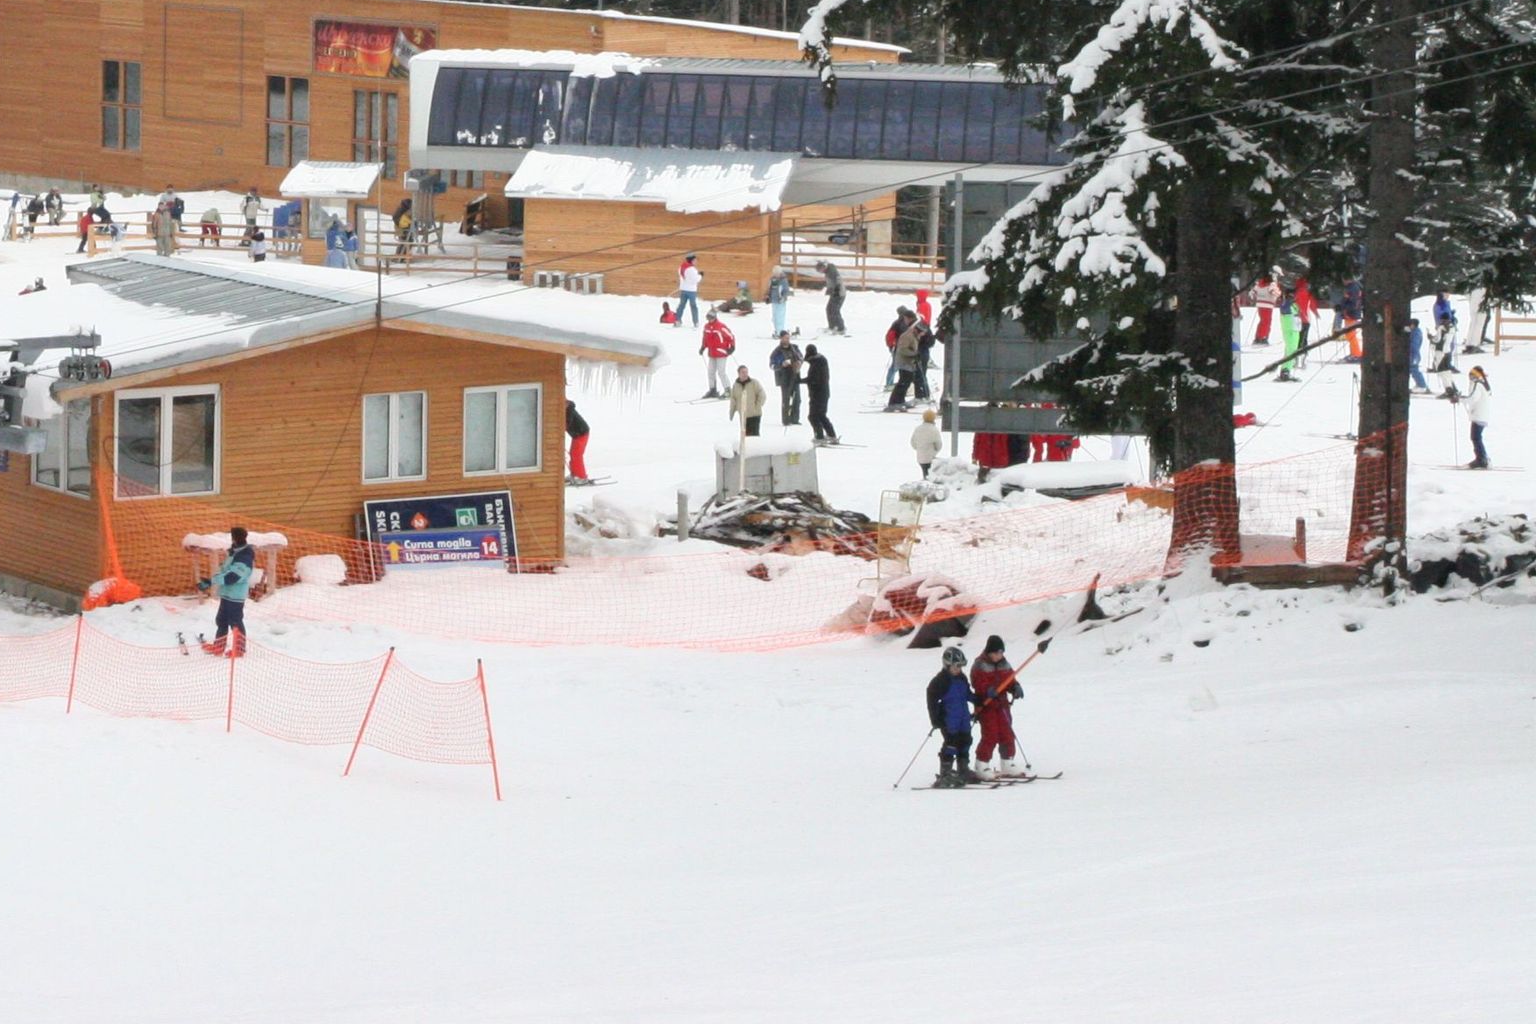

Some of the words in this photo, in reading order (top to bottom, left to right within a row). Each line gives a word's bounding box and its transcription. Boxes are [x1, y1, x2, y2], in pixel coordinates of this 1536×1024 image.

[404, 539, 434, 549] Curna
[437, 537, 472, 550] mogila
[482, 541, 498, 555] 14
[405, 552, 440, 563] Църна
